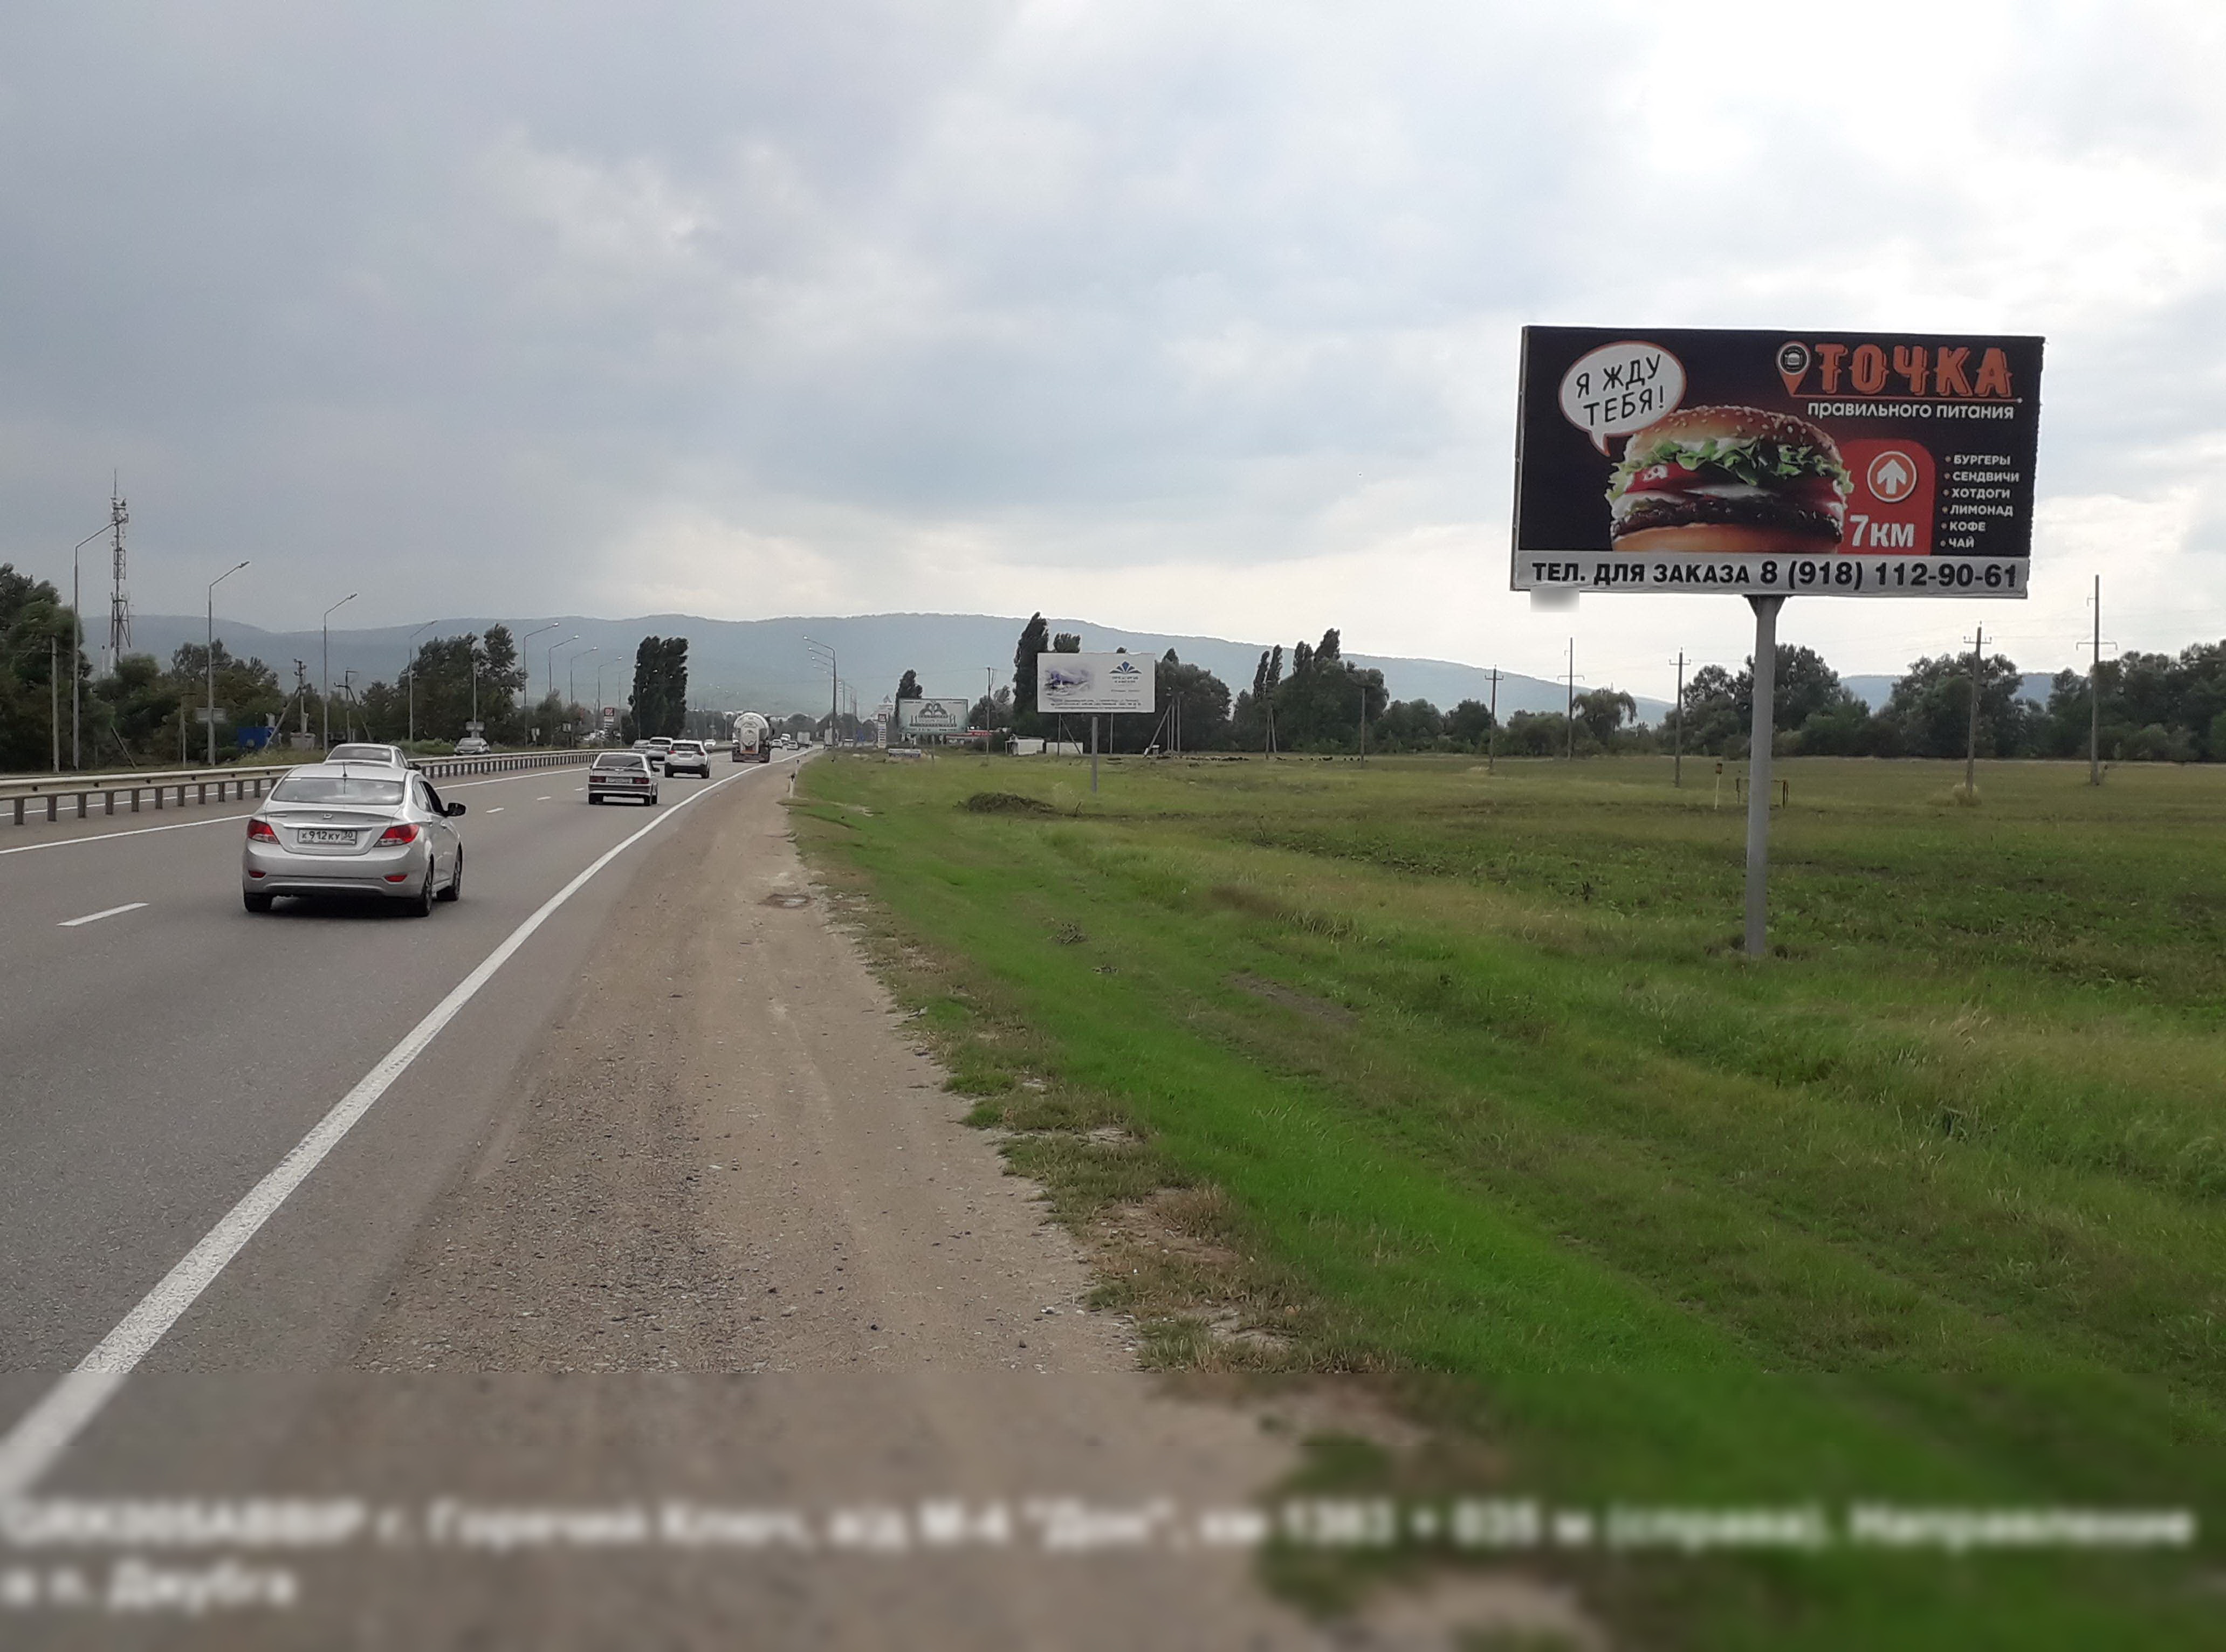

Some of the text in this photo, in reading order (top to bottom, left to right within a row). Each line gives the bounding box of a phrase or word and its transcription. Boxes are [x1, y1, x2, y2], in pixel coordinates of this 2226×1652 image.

[1576, 354, 1661, 399] Я ЖДУ
[1815, 343, 2012, 397] ТОЧКА
[1583, 384, 1664, 426] ТЕБЯ!
[1808, 402, 2014, 419] правильного питания
[1953, 455, 2011, 465] БУРГЕРЫ
[1952, 471, 2019, 483] СЕНДВИЧИ
[1952, 488, 2011, 500] ХОТДОГИ
[1949, 505, 2014, 517] ЛИМОНАД
[1949, 521, 1986, 531] КОФЕ
[1948, 535, 1975, 548] ЧАЙ
[1532, 560, 2017, 589] ТЕЛ. ДЛЯ ЗАКАЗА 8 (918) 112-90-61
